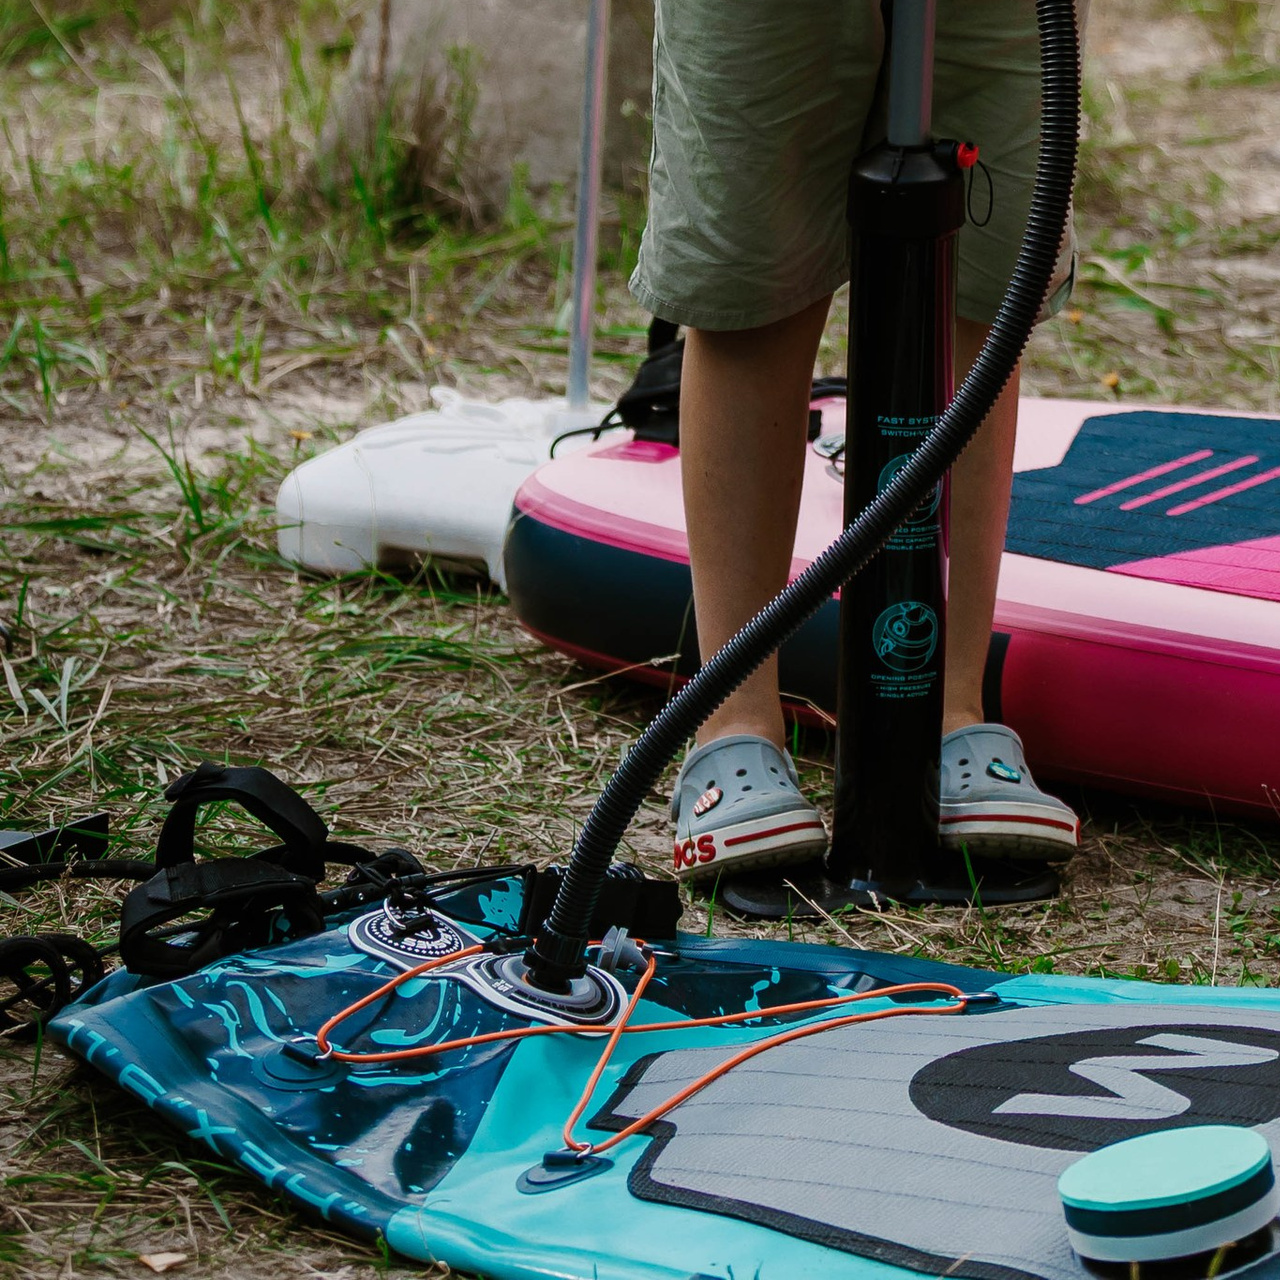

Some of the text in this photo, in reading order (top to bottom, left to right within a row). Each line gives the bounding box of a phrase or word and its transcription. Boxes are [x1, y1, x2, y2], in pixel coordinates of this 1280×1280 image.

[877, 415, 941, 425] FAST SYSTE
[881, 429, 931, 437] SWITCH-VA
[870, 674, 906, 682] OPENING
